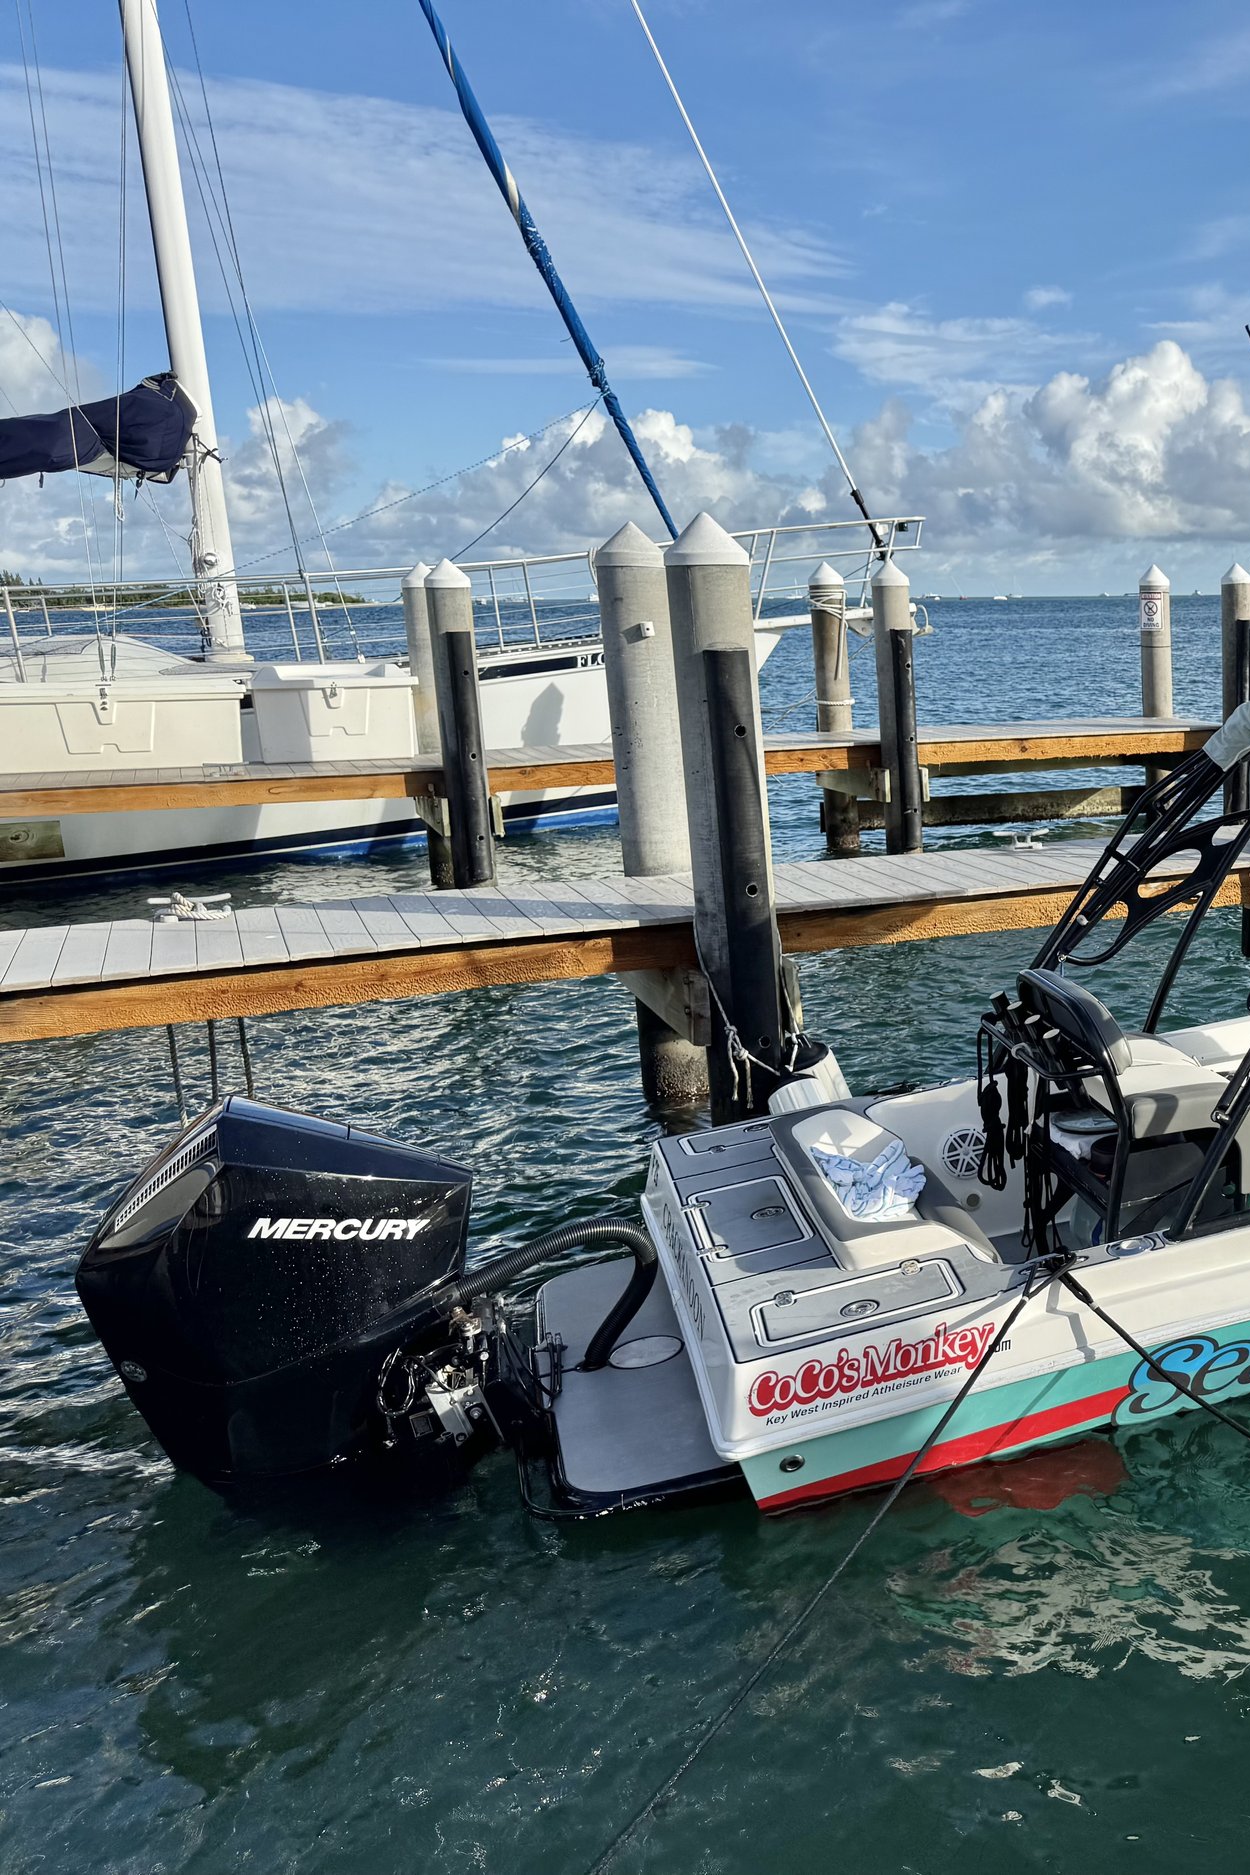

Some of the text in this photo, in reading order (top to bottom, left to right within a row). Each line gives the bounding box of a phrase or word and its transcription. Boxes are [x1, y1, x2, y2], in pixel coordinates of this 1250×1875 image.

[247, 1218, 430, 1242] MERCURY
[749, 1348, 861, 1417] CoCo's
[861, 1322, 995, 1388] Monkey
[766, 1366, 963, 1426] Key West Inspired Athleisure Wear
